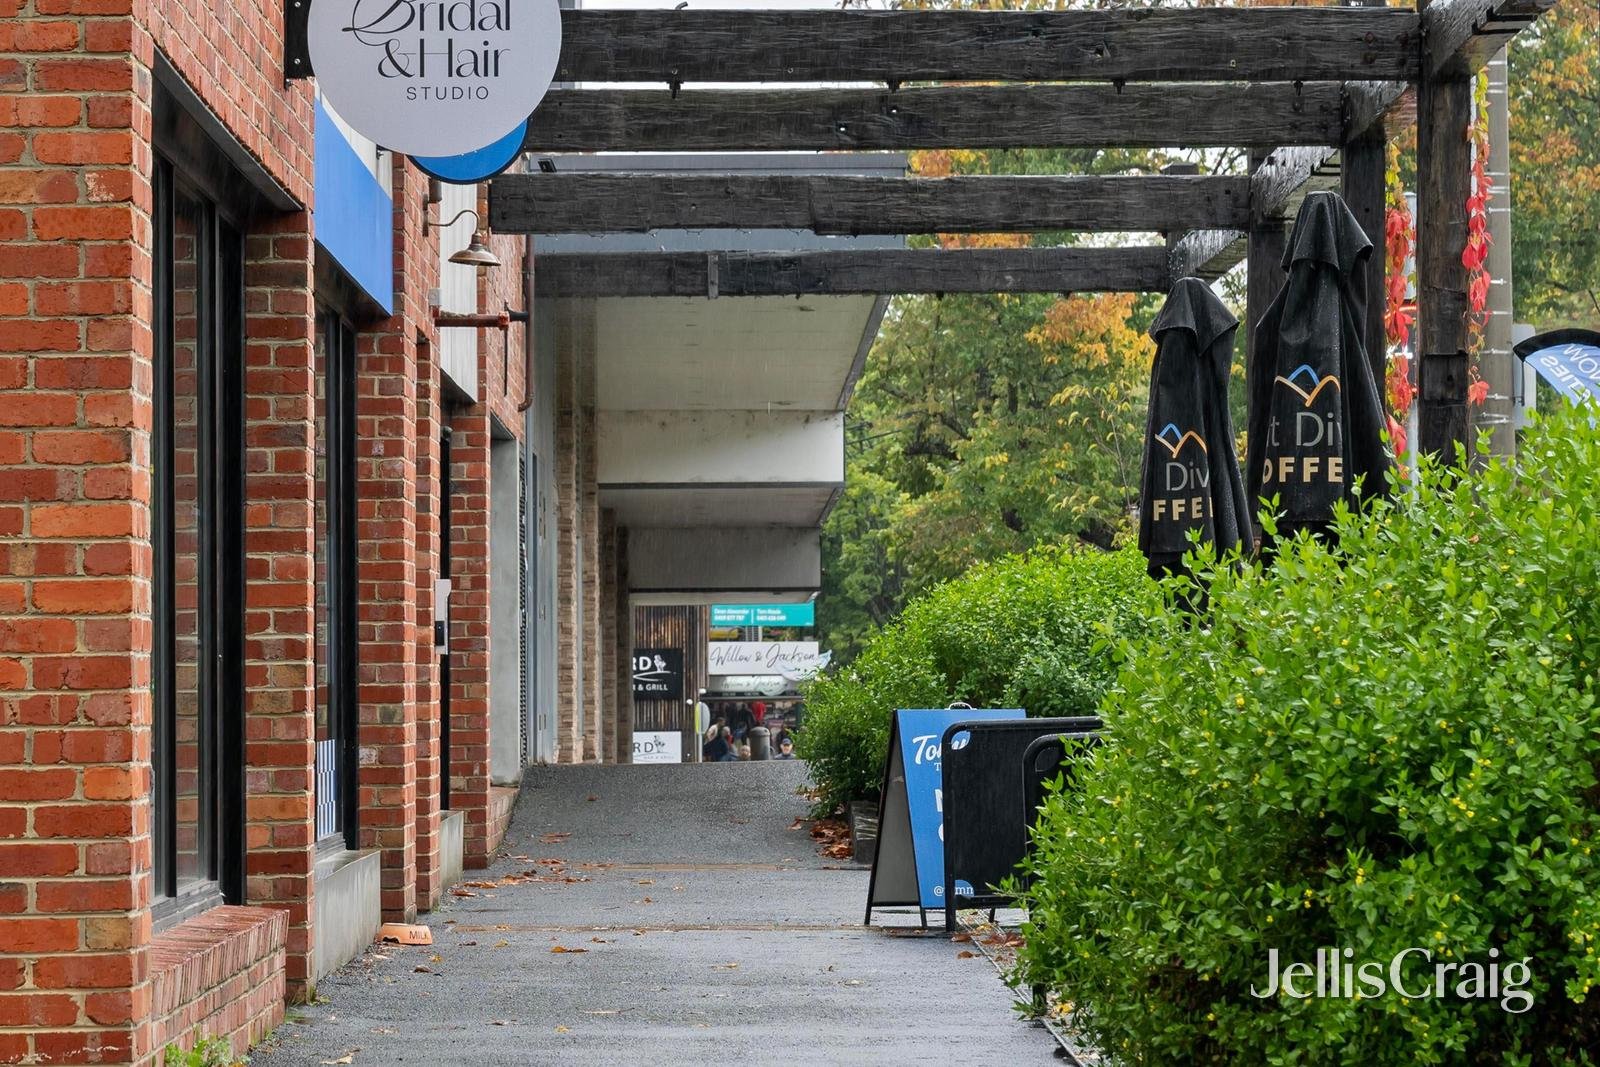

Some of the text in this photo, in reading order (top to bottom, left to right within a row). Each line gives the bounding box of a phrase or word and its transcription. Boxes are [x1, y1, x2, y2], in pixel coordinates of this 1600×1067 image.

[378, 38, 511, 78] &Hair
[406, 86, 489, 100] STUDIO
[1296, 411, 1342, 447] Di
